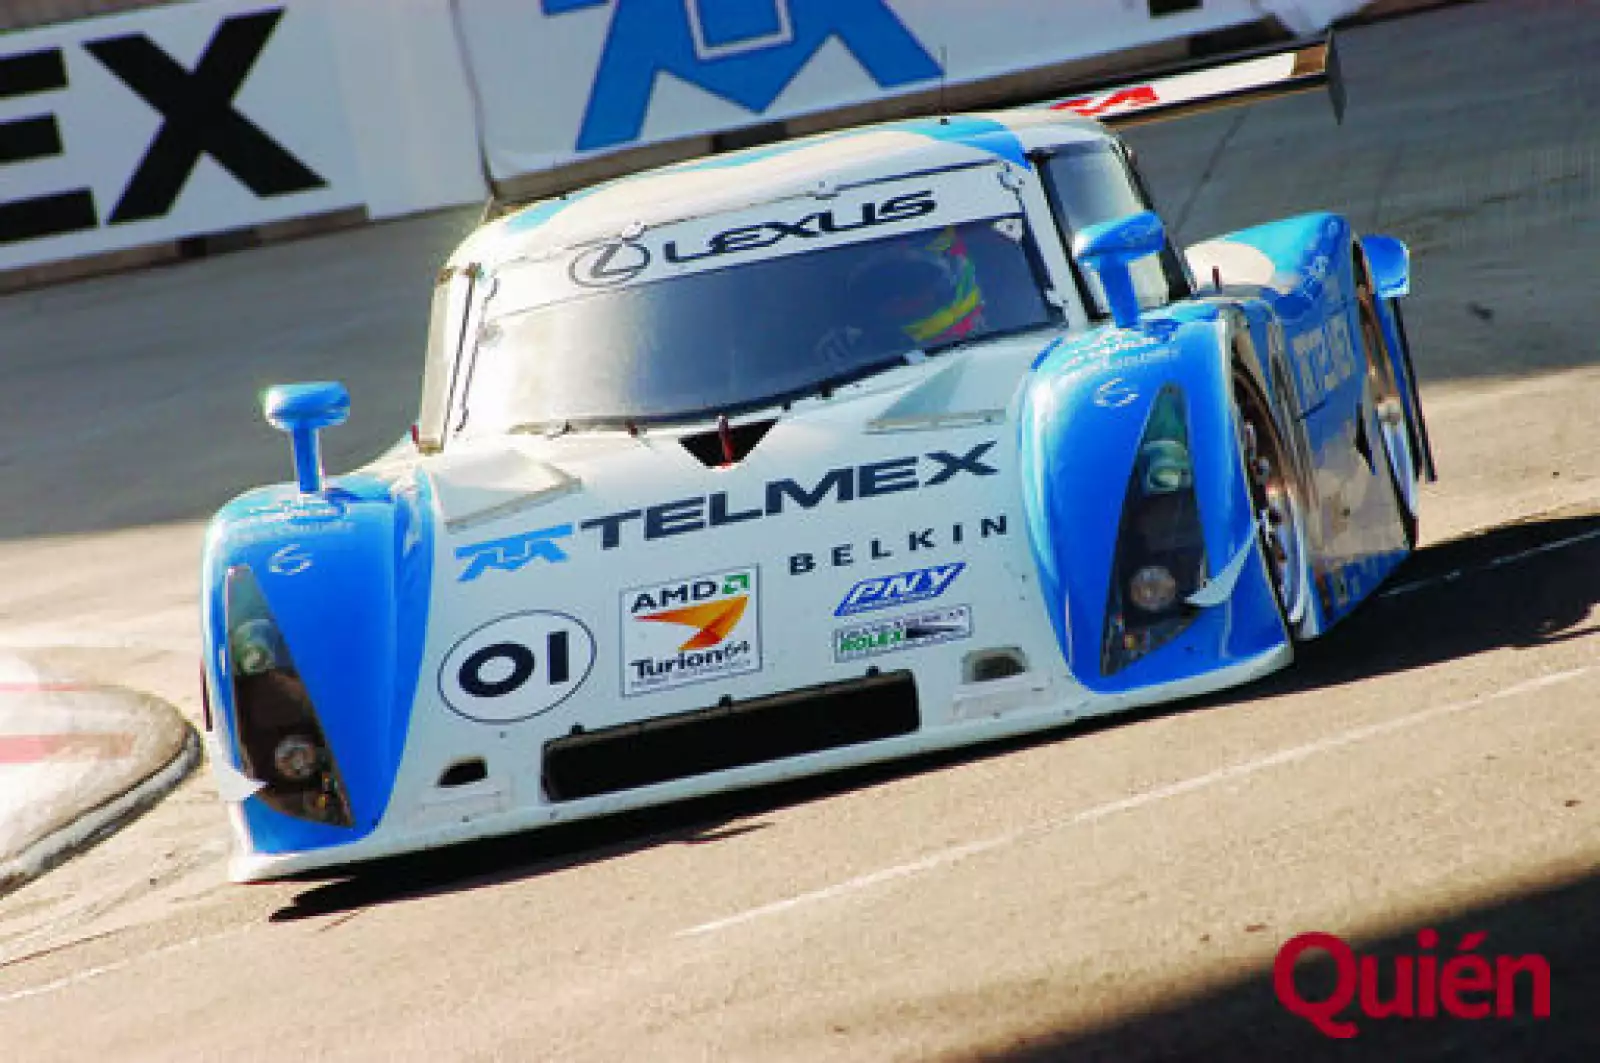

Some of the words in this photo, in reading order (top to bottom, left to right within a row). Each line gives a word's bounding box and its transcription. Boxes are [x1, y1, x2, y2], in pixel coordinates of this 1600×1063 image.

[662, 189, 938, 264] LEXUS
[580, 440, 998, 550] TELMEX
[788, 514, 1008, 576] BELKIN
[630, 580, 719, 614] AMD
[845, 563, 959, 606] PNY
[457, 629, 571, 698] 01
